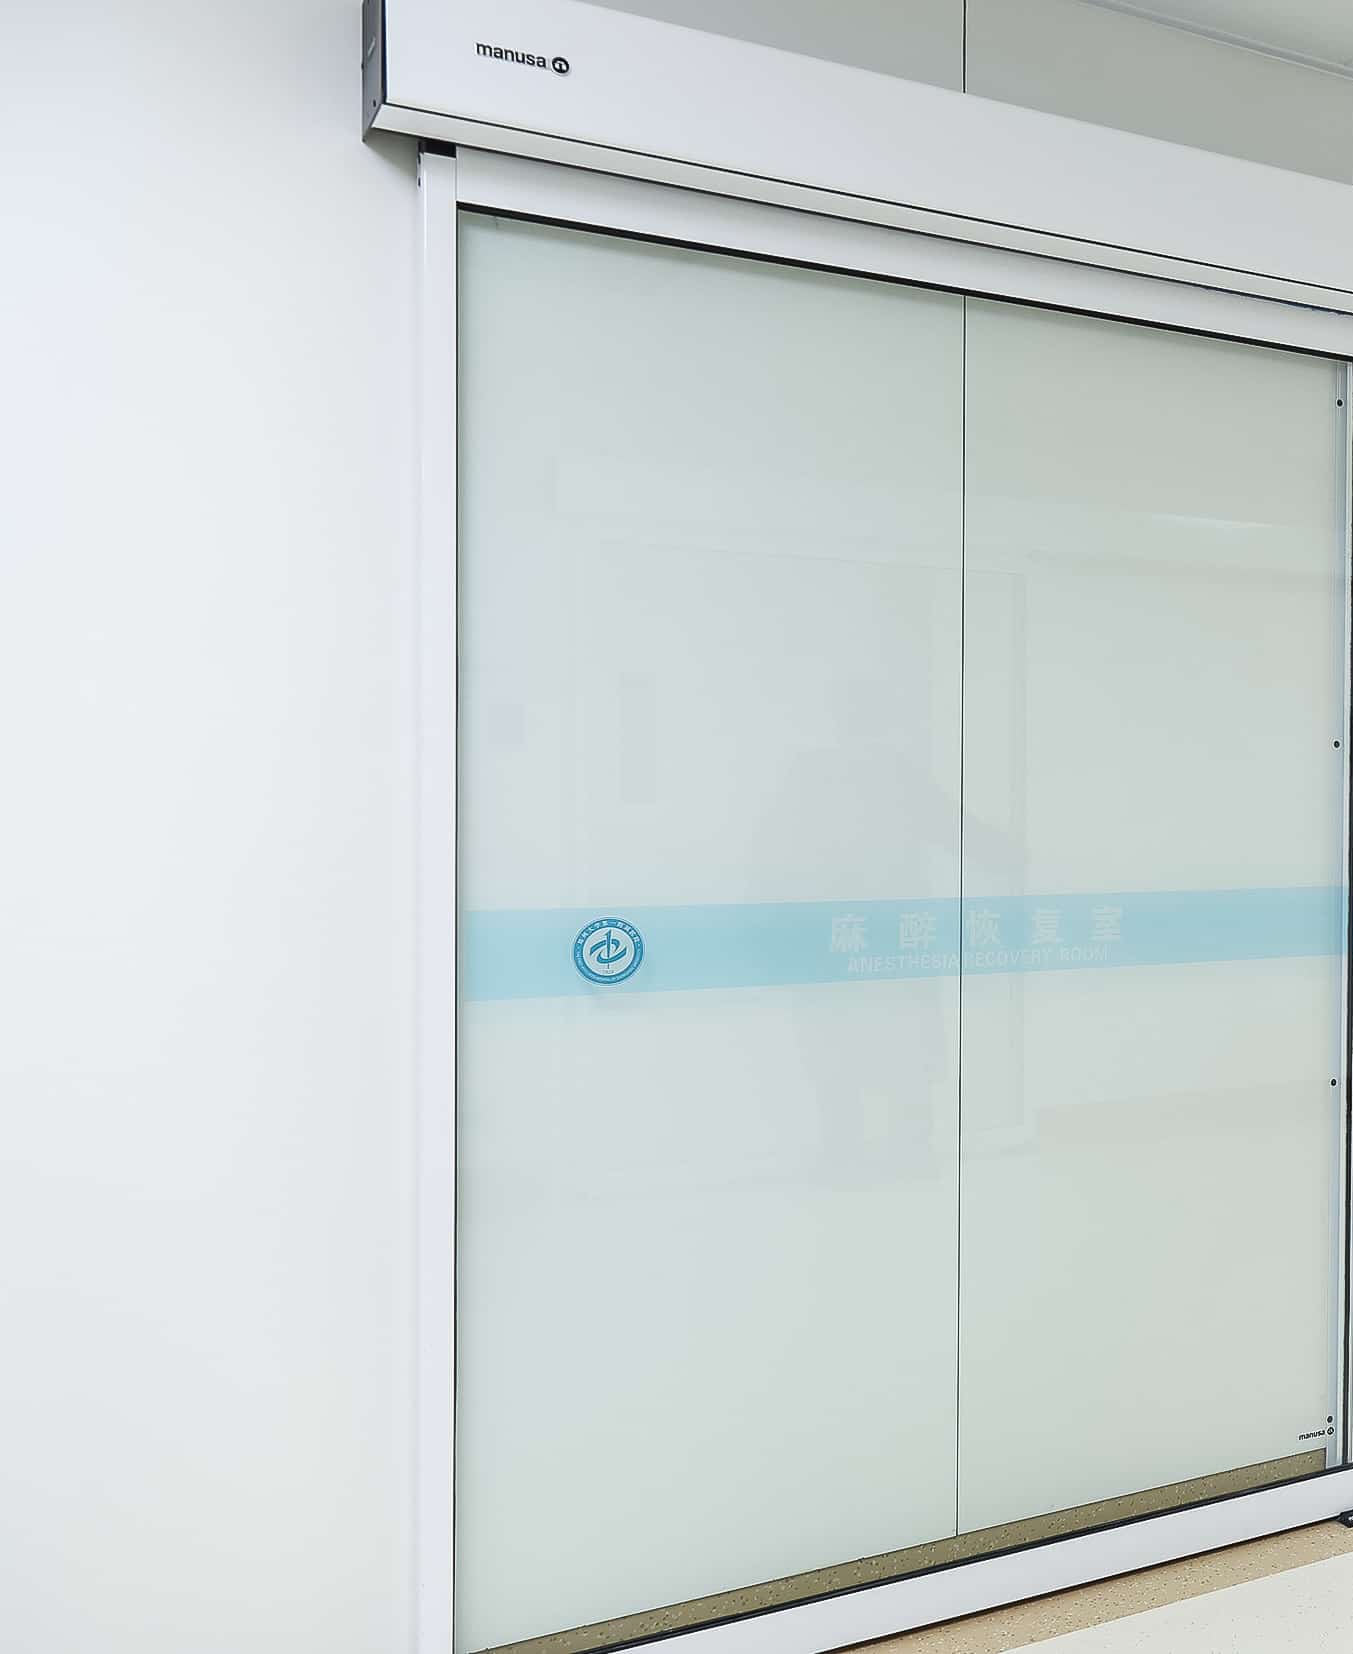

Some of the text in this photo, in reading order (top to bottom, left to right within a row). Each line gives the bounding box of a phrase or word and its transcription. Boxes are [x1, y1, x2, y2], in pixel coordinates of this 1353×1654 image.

[475, 42, 547, 68] manusa
[830, 904, 1122, 953] 麻醉恢复室
[1298, 1428, 1326, 1441] manusa
